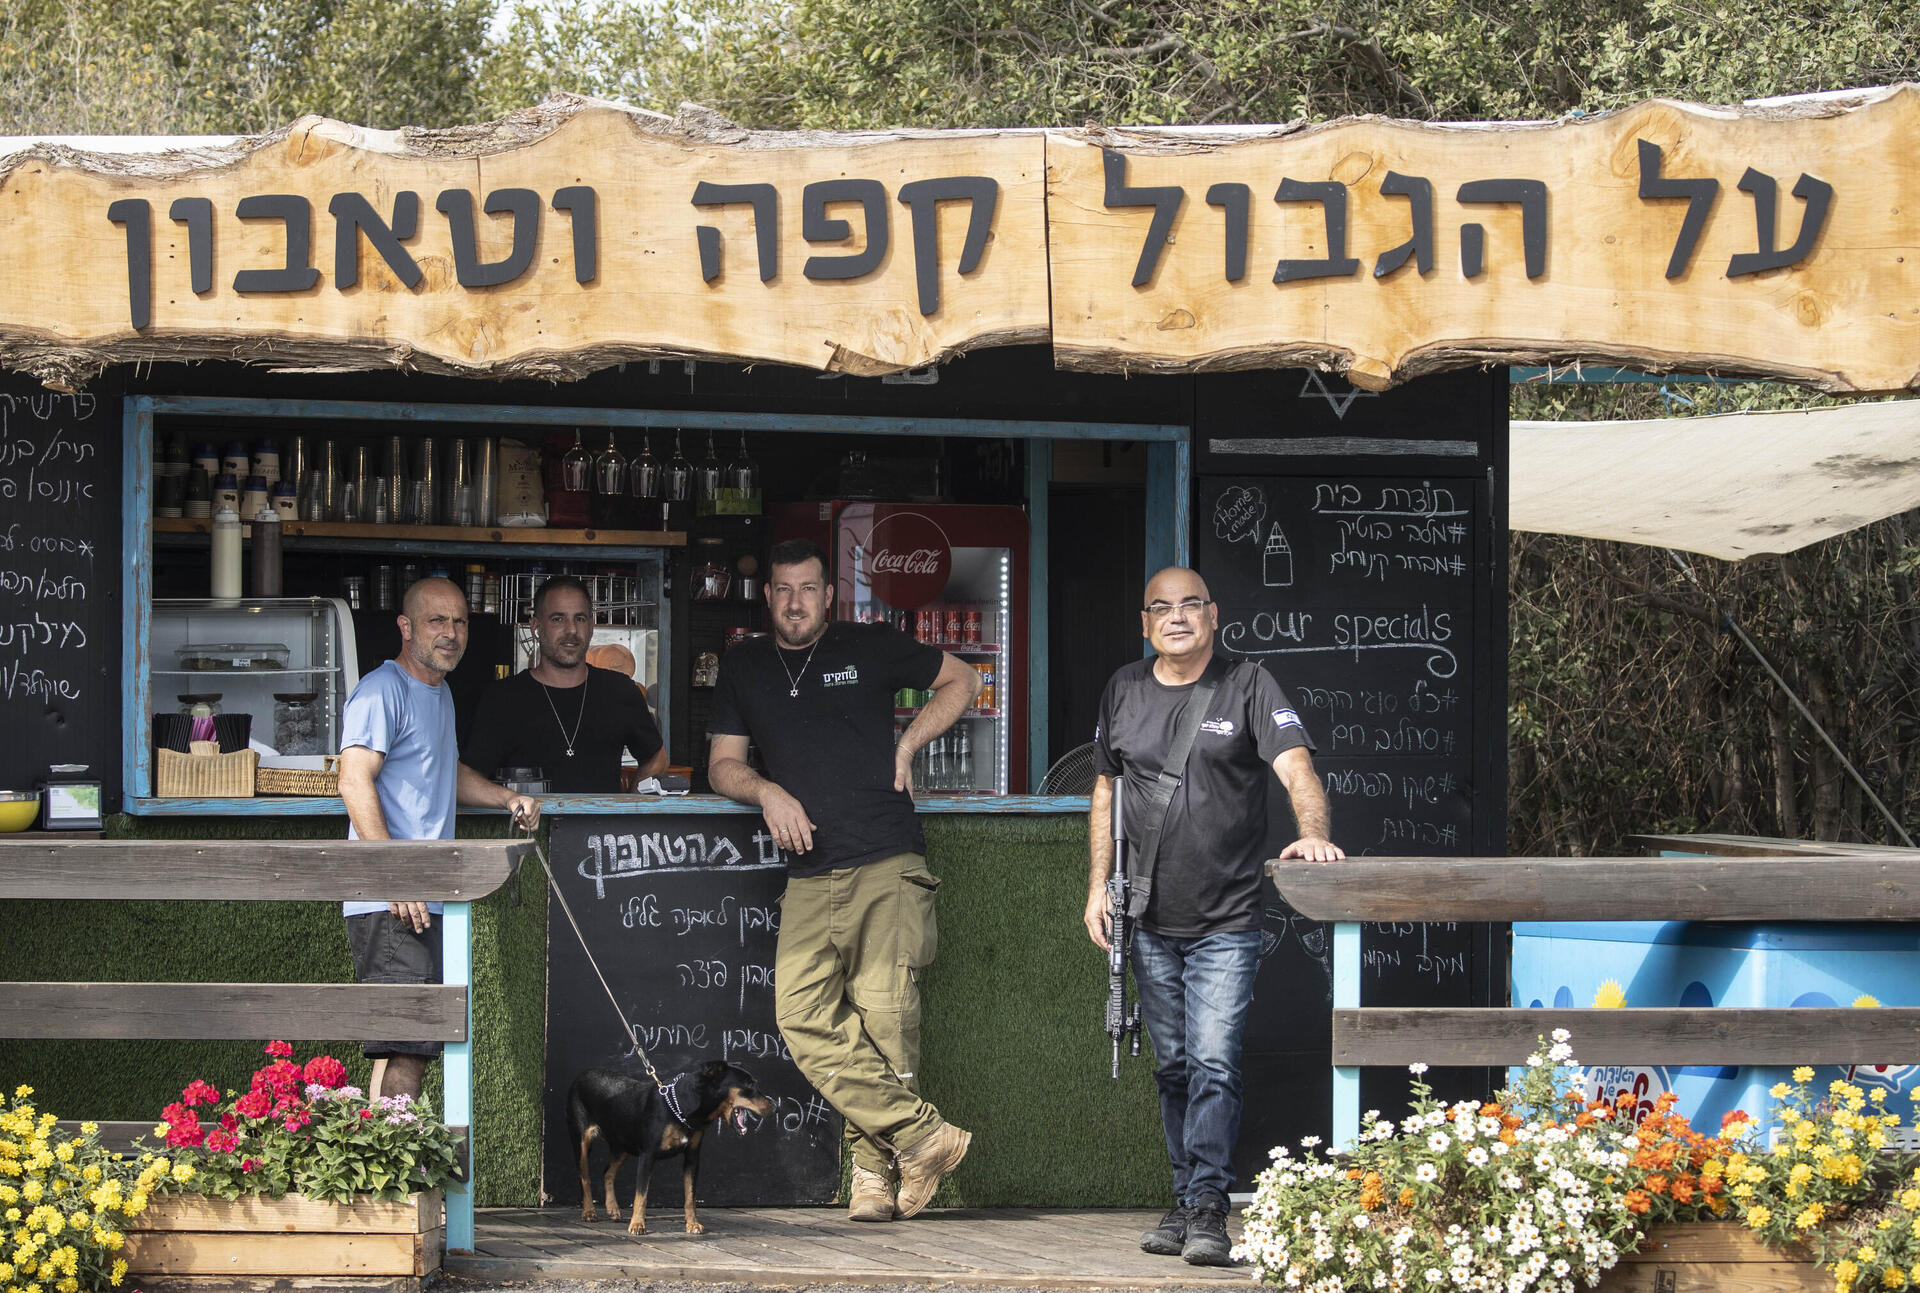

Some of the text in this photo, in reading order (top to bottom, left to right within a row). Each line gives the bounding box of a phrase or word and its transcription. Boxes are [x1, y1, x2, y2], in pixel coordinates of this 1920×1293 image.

[107, 138, 1833, 330] על הגבול קפה וטאבון
[1218, 491, 1253, 525] Home
[1312, 481, 1455, 518] תוצרת בית
[1231, 505, 1256, 533] made
[1336, 515, 1392, 552] בוטיק
[872, 549, 942, 574] Coca-Cola
[1330, 551, 1389, 582] קינוחים
[0, 611, 86, 655] מילקש
[1297, 687, 1353, 723] הקפה
[1332, 725, 1366, 750] חם
[587, 832, 743, 899] מהטאבון
[619, 893, 661, 928] גלילי
[738, 906, 780, 947] אבון
[676, 959, 775, 1013] אבון פיצה
[1604, 1080, 1615, 1096] של
